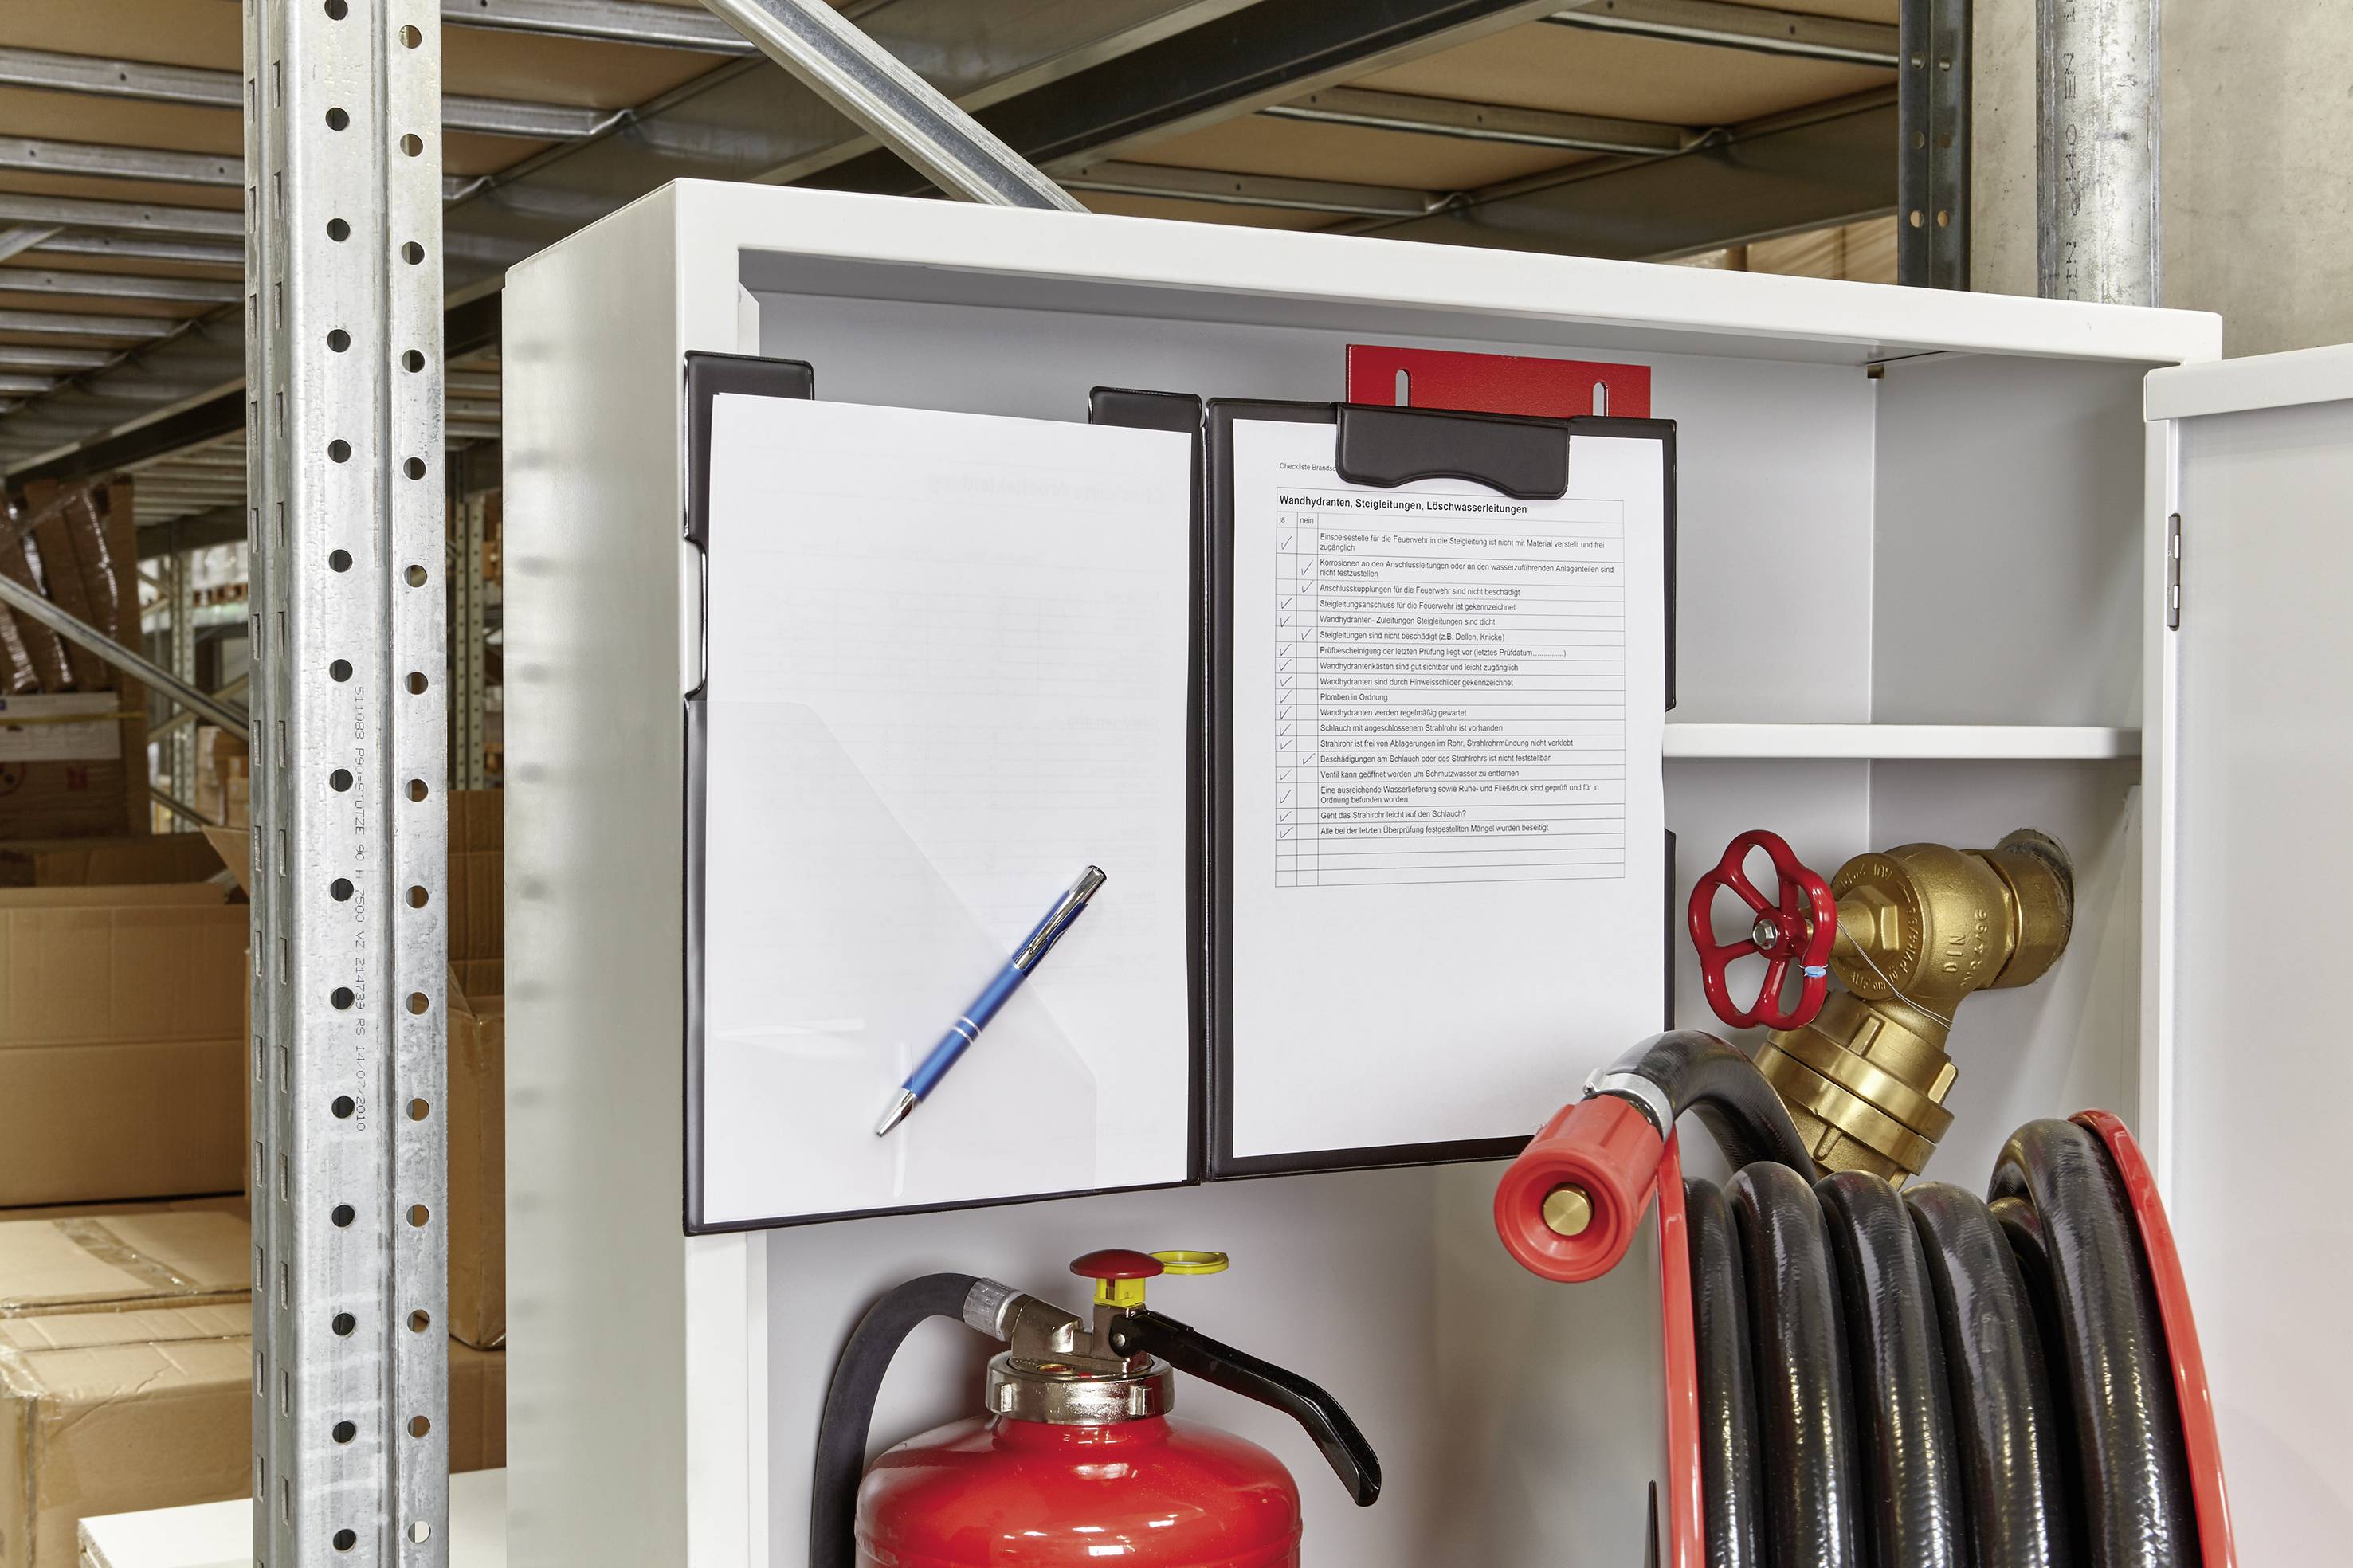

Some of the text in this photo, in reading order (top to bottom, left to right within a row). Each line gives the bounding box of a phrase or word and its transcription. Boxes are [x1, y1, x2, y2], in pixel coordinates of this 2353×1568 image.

[2063, 53, 2077, 99] EN
[1279, 495, 1527, 515] Wandhydranten, Steigleitungen, Löschwasserleitungen
[1320, 532, 1369, 542] Einspeisestelle
[1393, 535, 1428, 543] Feuerwehr
[1449, 537, 1487, 547] Steigleitung
[1320, 543, 1355, 552] zugänglich
[1385, 560, 1449, 570] Anschlussleitungen
[1337, 568, 1378, 577] festzustellen
[1319, 584, 1391, 594] Anschlusskupplungen
[1415, 586, 1451, 594] Feuerwehr
[1484, 588, 1520, 597] beschädigt
[1320, 599, 1394, 610] Steigleitungsanschluss
[1464, 602, 1516, 611] gekennzeichnet
[1319, 615, 1375, 625] Wandhydranten-
[1375, 616, 1414, 625] Zuleitungen
[1416, 617, 1462, 626] Steigleitungen
[1320, 630, 1367, 641] Steigleitungen
[1401, 632, 1437, 641] beschädigt
[1480, 633, 1504, 642] Knicke)
[1320, 646, 1381, 657] Prüfbescheinigung
[1418, 647, 1445, 657] Prüfung
[1446, 648, 1460, 657] liegt
[1320, 662, 1394, 671] Wandhydrantenkästen
[1320, 677, 1372, 687] Wandhydranten
[1461, 679, 1513, 688] gekennzeichnet
[1359, 693, 1388, 703] Ordnung
[354, 686, 366, 739] 511083
[1320, 708, 1372, 718] Wandhydranten
[1399, 708, 1437, 718] regelmäßig
[1437, 709, 1466, 718] gewartet
[1364, 724, 1423, 733] angeschlossenem
[1390, 739, 1436, 748] Ablagerungen
[1447, 739, 1465, 747] Rohr,
[1466, 739, 1529, 748] Strahlrohrmündung
[1320, 755, 1375, 764] Beschädigungen
[1358, 770, 1386, 779] geöffnet
[1544, 783, 1568, 793] geprüft
[1320, 796, 1350, 805] Ordnung
[1382, 825, 1424, 835] Überprüfung
[1470, 825, 1495, 833] Mängel
[1521, 824, 1549, 833] beseitigt
[354, 843, 366, 861] 90
[355, 888, 366, 923] 7500
[355, 930, 366, 949] VZ
[1943, 934, 1966, 973] DIN
[355, 956, 366, 1010] 214739
[355, 1017, 366, 1037] RS
[355, 1045, 367, 1132] 14/07/2010
